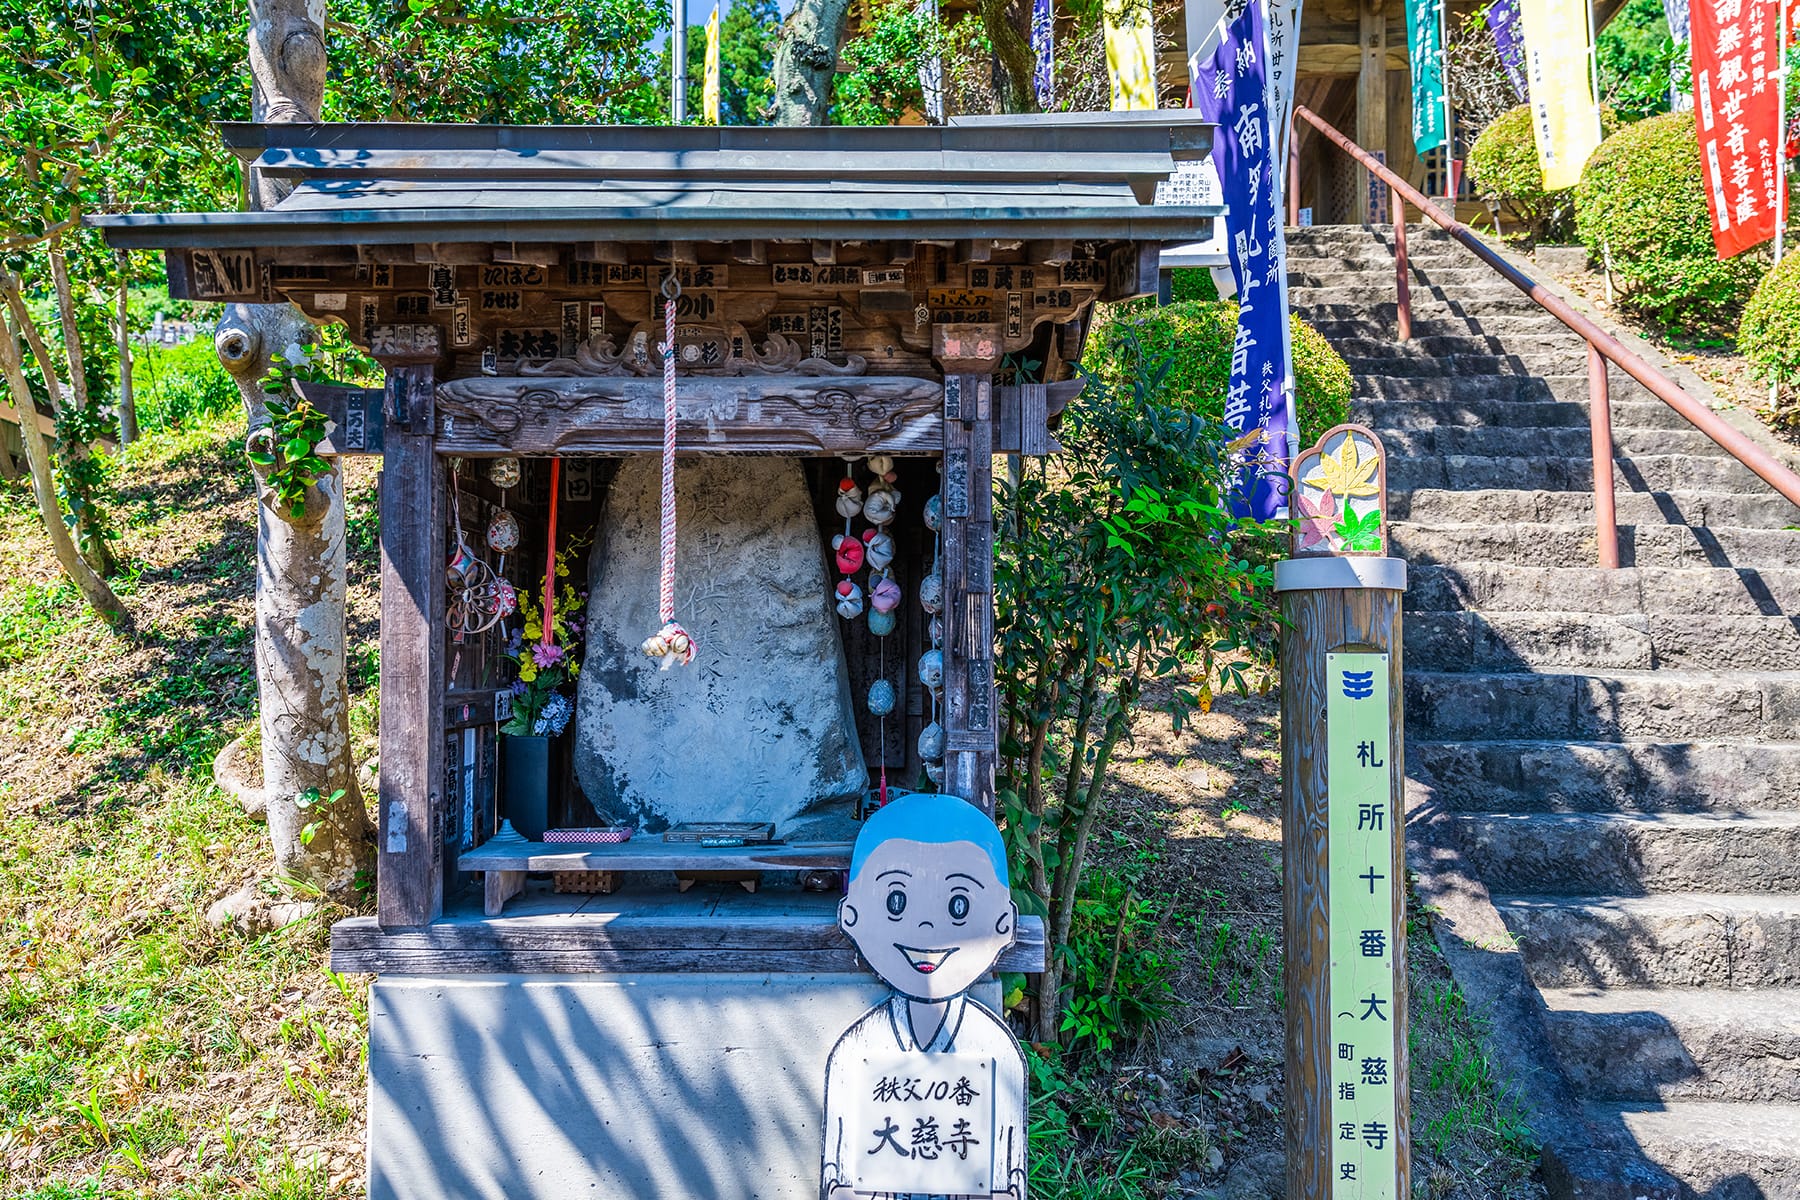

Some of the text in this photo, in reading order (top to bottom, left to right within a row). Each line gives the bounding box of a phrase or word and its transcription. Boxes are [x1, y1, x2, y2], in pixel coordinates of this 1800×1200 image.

[1357, 741, 1389, 1150] 札所十番大慈寺
[872, 1076, 980, 1107] 秩父10番
[867, 1115, 980, 1161] 大慈寺
